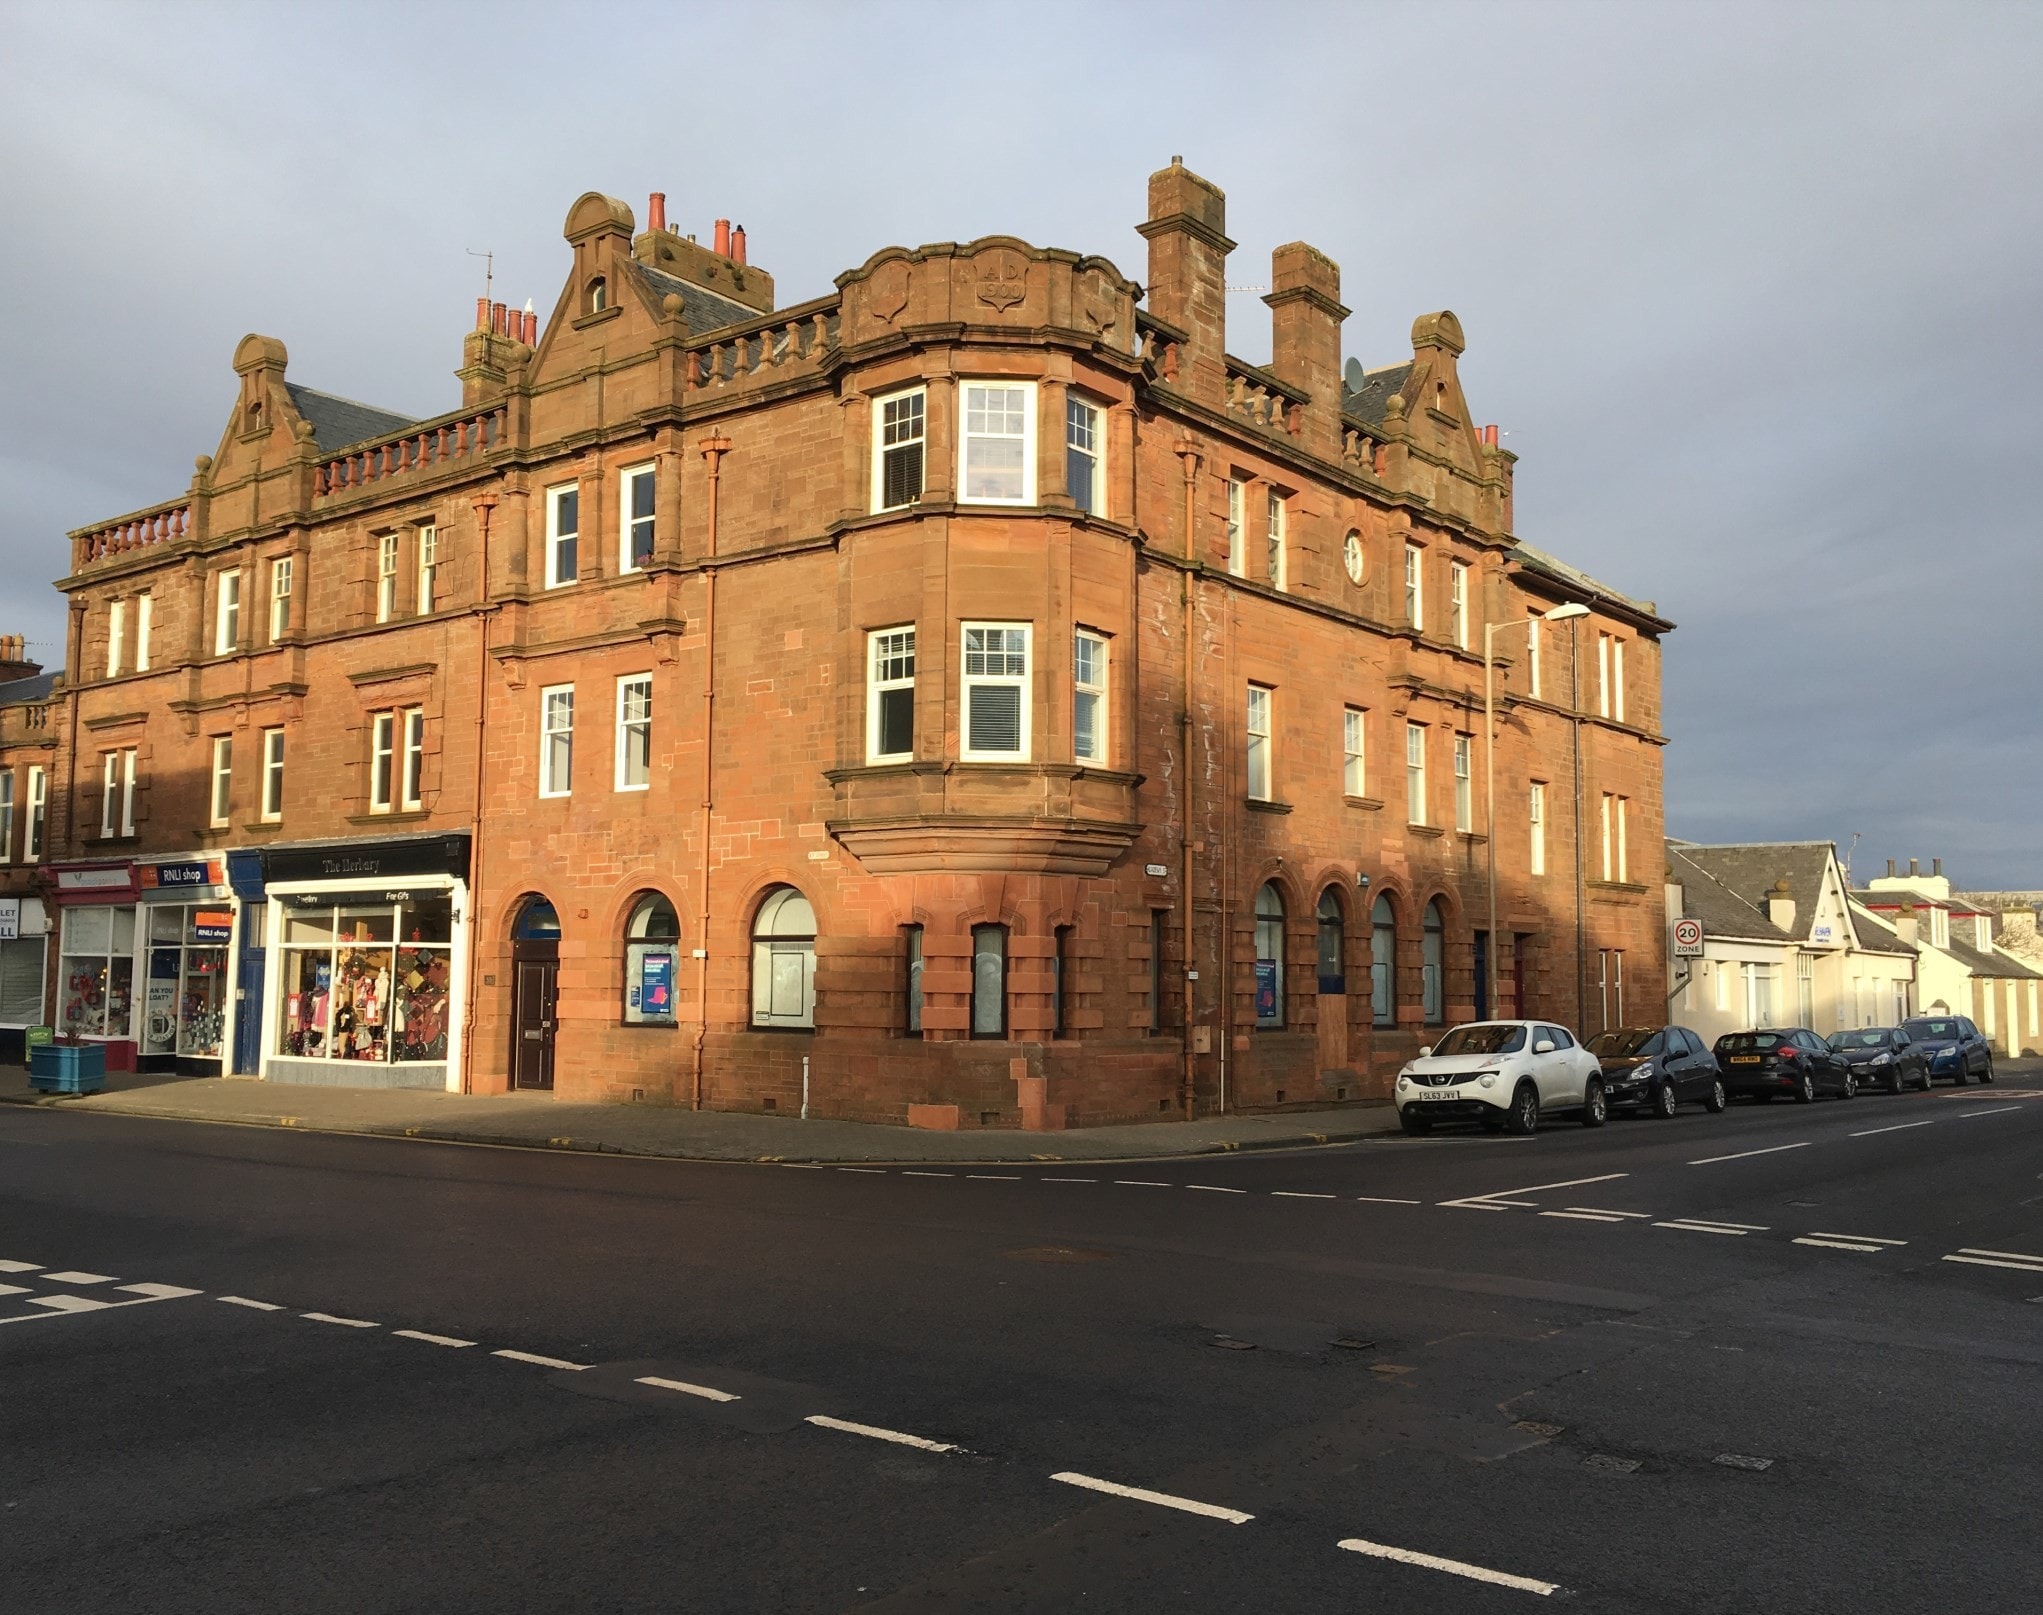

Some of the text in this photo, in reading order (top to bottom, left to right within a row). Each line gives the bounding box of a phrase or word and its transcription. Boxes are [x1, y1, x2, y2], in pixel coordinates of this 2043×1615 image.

[980, 284, 1020, 298] 1900
[322, 857, 379, 874] The Herbary
[163, 867, 201, 883] RNLI shop
[0, 909, 16, 917] LET
[0, 926, 15, 937] LL
[198, 929, 213, 937] RNLI
[213, 929, 229, 938] shop
[1679, 927, 1697, 938] 20
[1676, 945, 1700, 953] ZONE
[1423, 1092, 1441, 1100] SL63
